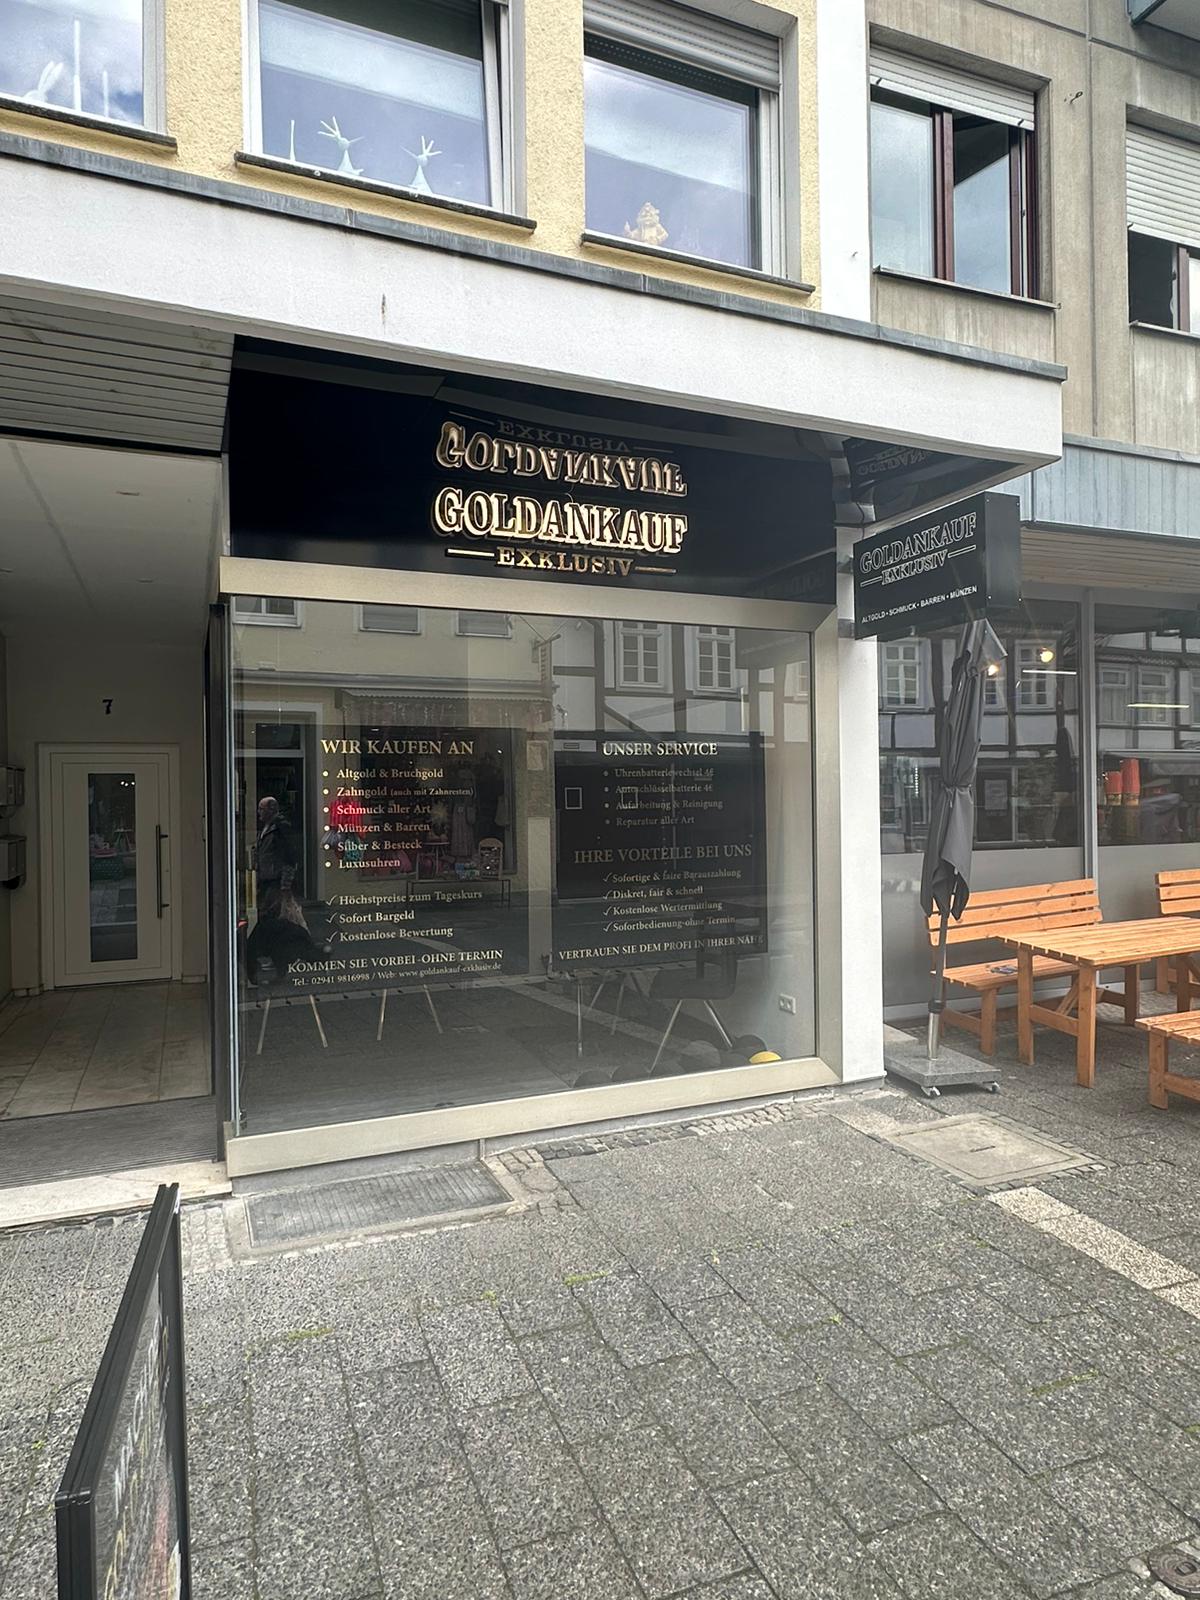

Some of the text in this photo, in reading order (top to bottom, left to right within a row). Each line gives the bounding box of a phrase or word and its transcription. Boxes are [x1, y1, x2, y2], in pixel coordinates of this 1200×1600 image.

[434, 487, 688, 553] GOLDANKAUF
[860, 512, 976, 574] GOLDANKAUF
[497, 546, 634, 576] EXKLUSIV
[881, 549, 948, 585] EXKLUSIV
[861, 585, 977, 623] ALTGOLD SCHMUCK BARREN MÜNZEN
[102, 699, 113, 715] 7
[320, 739, 474, 754] WIR KAUFEN AN
[602, 742, 718, 756] UNSER SERVICE
[336, 768, 444, 780] Altgold & Bruchgold
[336, 786, 474, 799] Zahngold (auch mit Zahnresten)
[336, 804, 431, 815] Schmuck aller Art
[683, 799, 723, 811] Reinigung
[337, 822, 430, 833] Münzen & Barren
[616, 816, 695, 829] Reparatur aller Art
[338, 839, 422, 851] Silber & Besteck
[574, 844, 752, 864] IHRE VORTEILE BEI UNS
[339, 857, 401, 869] Luxusuhren
[612, 873, 651, 886] Sofortige
[653, 873, 660, 881] &
[662, 870, 682, 881] faire
[339, 890, 483, 908] Höchstpreise zum Tageskurs
[613, 886, 703, 899] Diskret, fair & schnell
[613, 901, 722, 916] Kostenlose Wertermittlung
[339, 910, 415, 924] Sofort Bargeld
[706, 916, 736, 926] Termin
[339, 927, 454, 942] Kostenlose Bewertung
[559, 946, 620, 960] VERTRAUEN
[622, 943, 638, 954] SIE
[639, 942, 661, 953] DEM
[663, 940, 692, 951] PROFI
[694, 939, 704, 949] IN
[707, 937, 736, 948] IHRER
[288, 960, 346, 973] KOMMEN
[349, 959, 368, 969] SIE
[458, 949, 503, 961] TERMIN
[311, 974, 335, 986] 02941
[337, 972, 370, 984] 9816998
